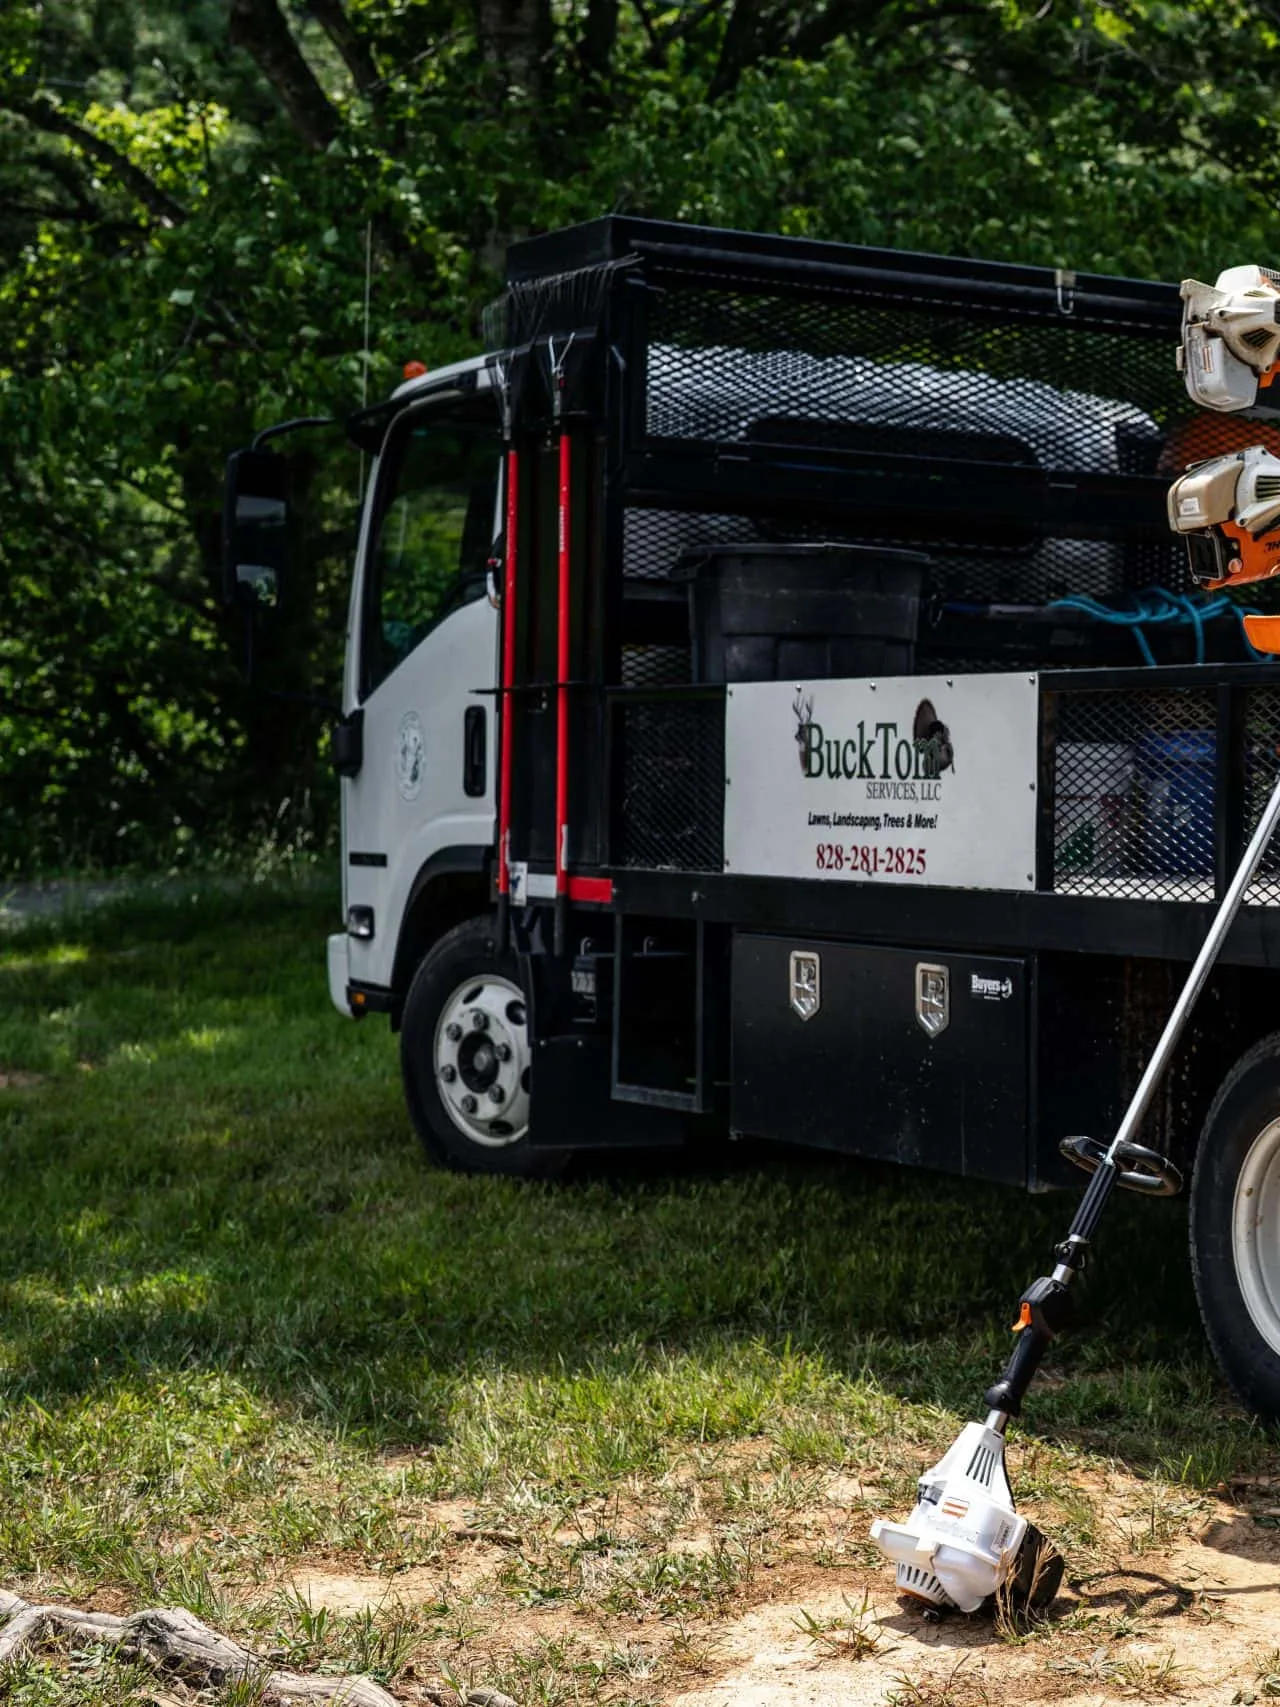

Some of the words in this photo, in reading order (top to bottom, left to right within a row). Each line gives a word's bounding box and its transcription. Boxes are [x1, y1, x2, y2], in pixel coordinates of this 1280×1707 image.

[804, 720, 942, 781] BuckTom
[866, 781, 919, 803] SERVICES,
[921, 783, 942, 801] LLC
[808, 811, 832, 829] Lawns,
[833, 812, 881, 831] Landscaping,
[883, 813, 905, 828] Trees
[906, 813, 912, 828] &
[914, 813, 938, 829] More!
[816, 843, 926, 875] 828-281-2825
